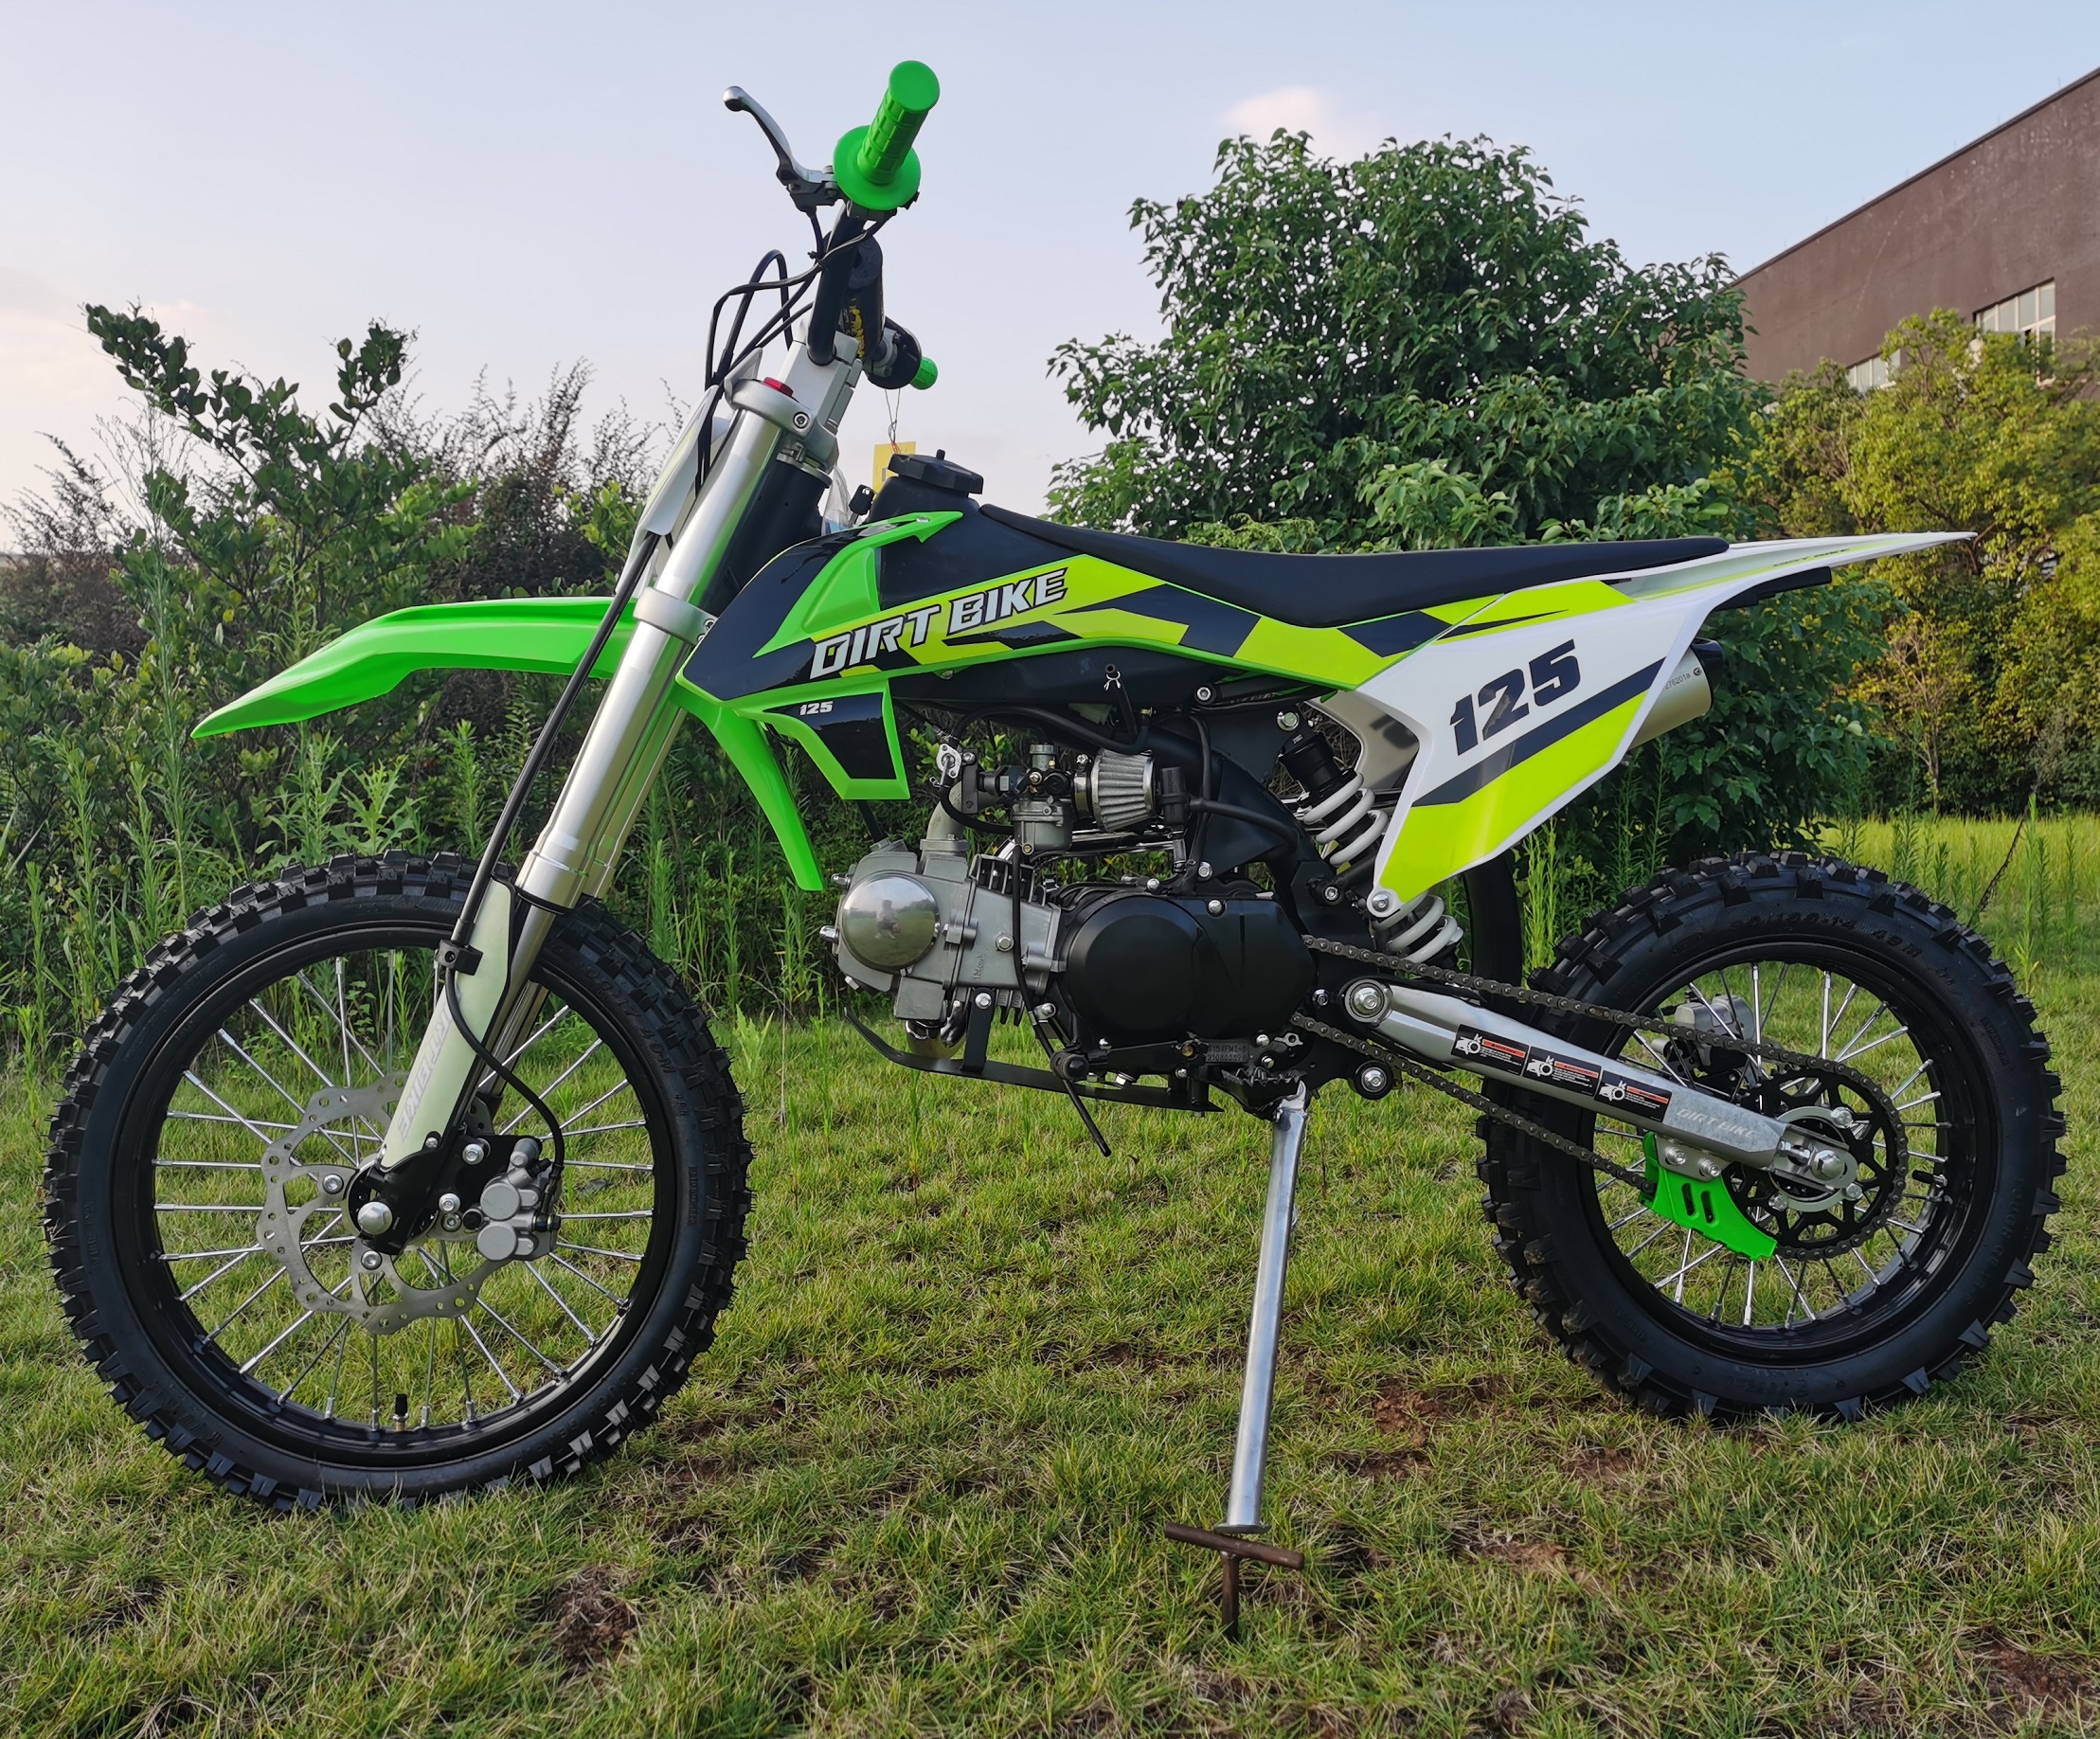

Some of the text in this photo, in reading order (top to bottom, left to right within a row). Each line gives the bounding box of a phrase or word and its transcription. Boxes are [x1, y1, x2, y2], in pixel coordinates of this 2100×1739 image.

[810, 567, 1068, 679] DIRT BIKE
[799, 701, 834, 716] 125
[1449, 638, 1581, 756] 125
[1676, 1108, 1719, 1125] DIRT
